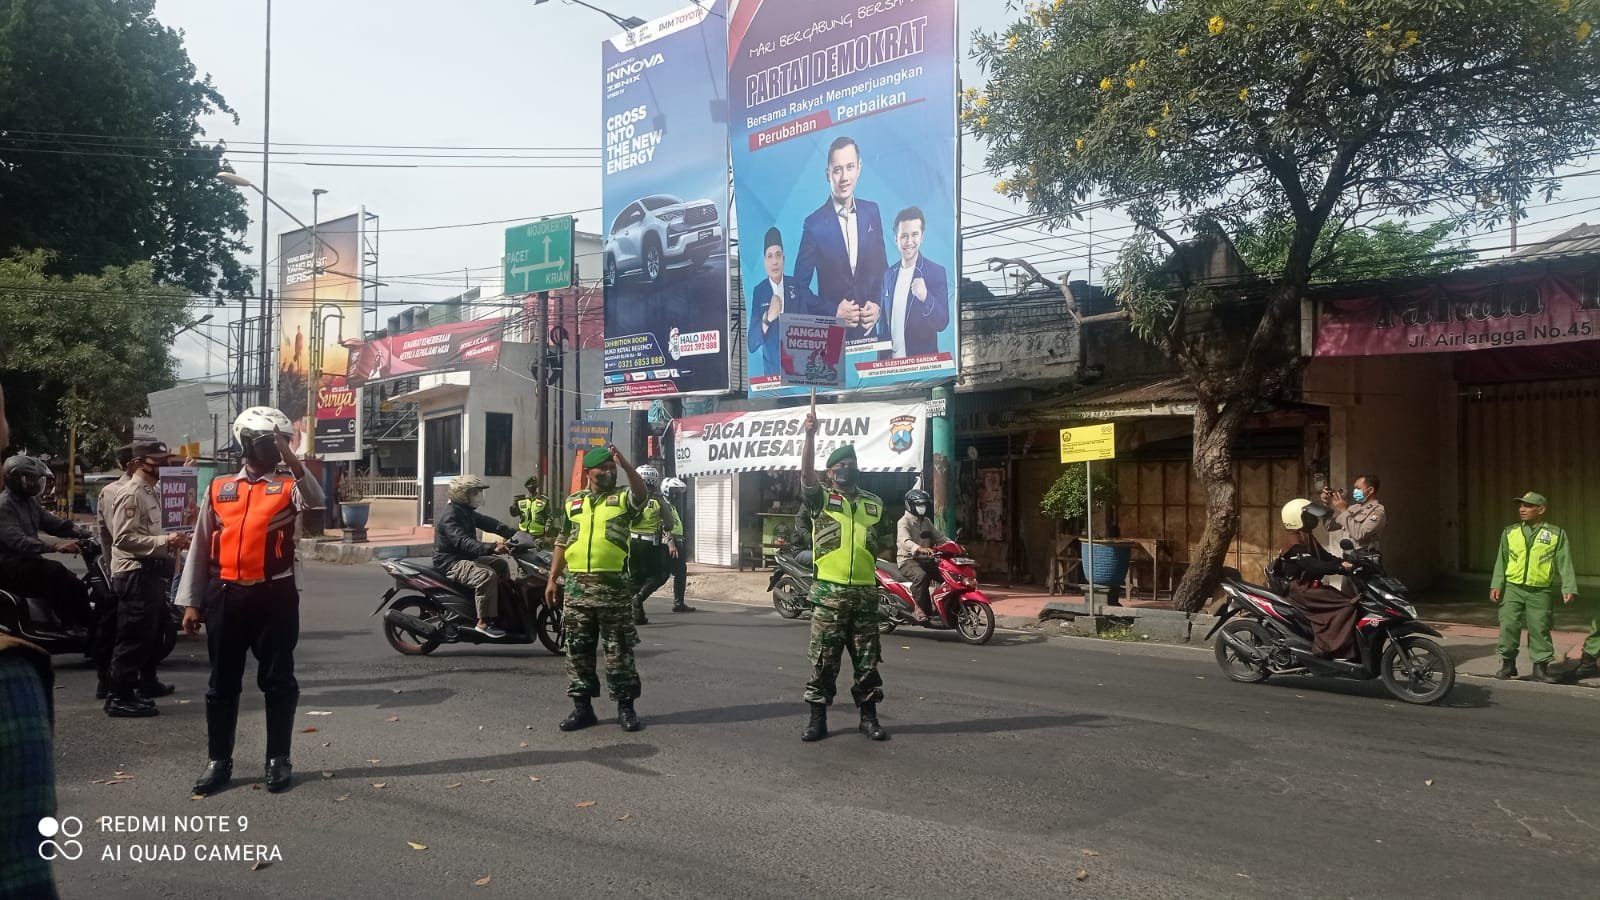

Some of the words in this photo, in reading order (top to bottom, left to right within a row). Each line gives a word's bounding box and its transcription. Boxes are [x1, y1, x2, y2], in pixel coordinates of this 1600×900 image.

[659, 18, 676, 32] IMM
[676, 7, 704, 25] TOYOTA
[749, 41, 776, 58] MARI
[779, 13, 854, 47] BERGABUNG
[606, 52, 665, 84] INNOVA
[746, 54, 809, 108] PARTAI
[811, 16, 928, 87] DEMOKRAT
[607, 75, 641, 92] ZENIX
[746, 109, 787, 128] Bersama
[789, 94, 824, 114] Rakyat
[826, 66, 923, 104] Memperjuangkan
[606, 105, 647, 131] CROSS
[758, 117, 817, 147] Perubahan
[837, 90, 907, 121] Perbaikan
[606, 124, 635, 146] INTO
[606, 140, 630, 160] THE
[632, 129, 663, 152] NEW
[606, 146, 656, 175] ENERGY
[526, 218, 570, 238] MOJOKERTO
[506, 249, 529, 264] PACET
[545, 270, 570, 285] KRIAN
[680, 334, 699, 344] HALO
[700, 332, 717, 342] IMM
[787, 327, 829, 338] JANGAN
[1408, 336, 1430, 348] Jl.
[1434, 330, 1527, 347] Airlangga
[1534, 320, 1592, 340] No.45
[788, 339, 828, 350] NGEBUT
[317, 387, 357, 416] Surya
[702, 421, 745, 441] JAGA
[708, 441, 742, 461] DAN
[162, 481, 187, 495] PAKAI
[165, 496, 185, 509] HELM
[168, 511, 182, 523] SNI
